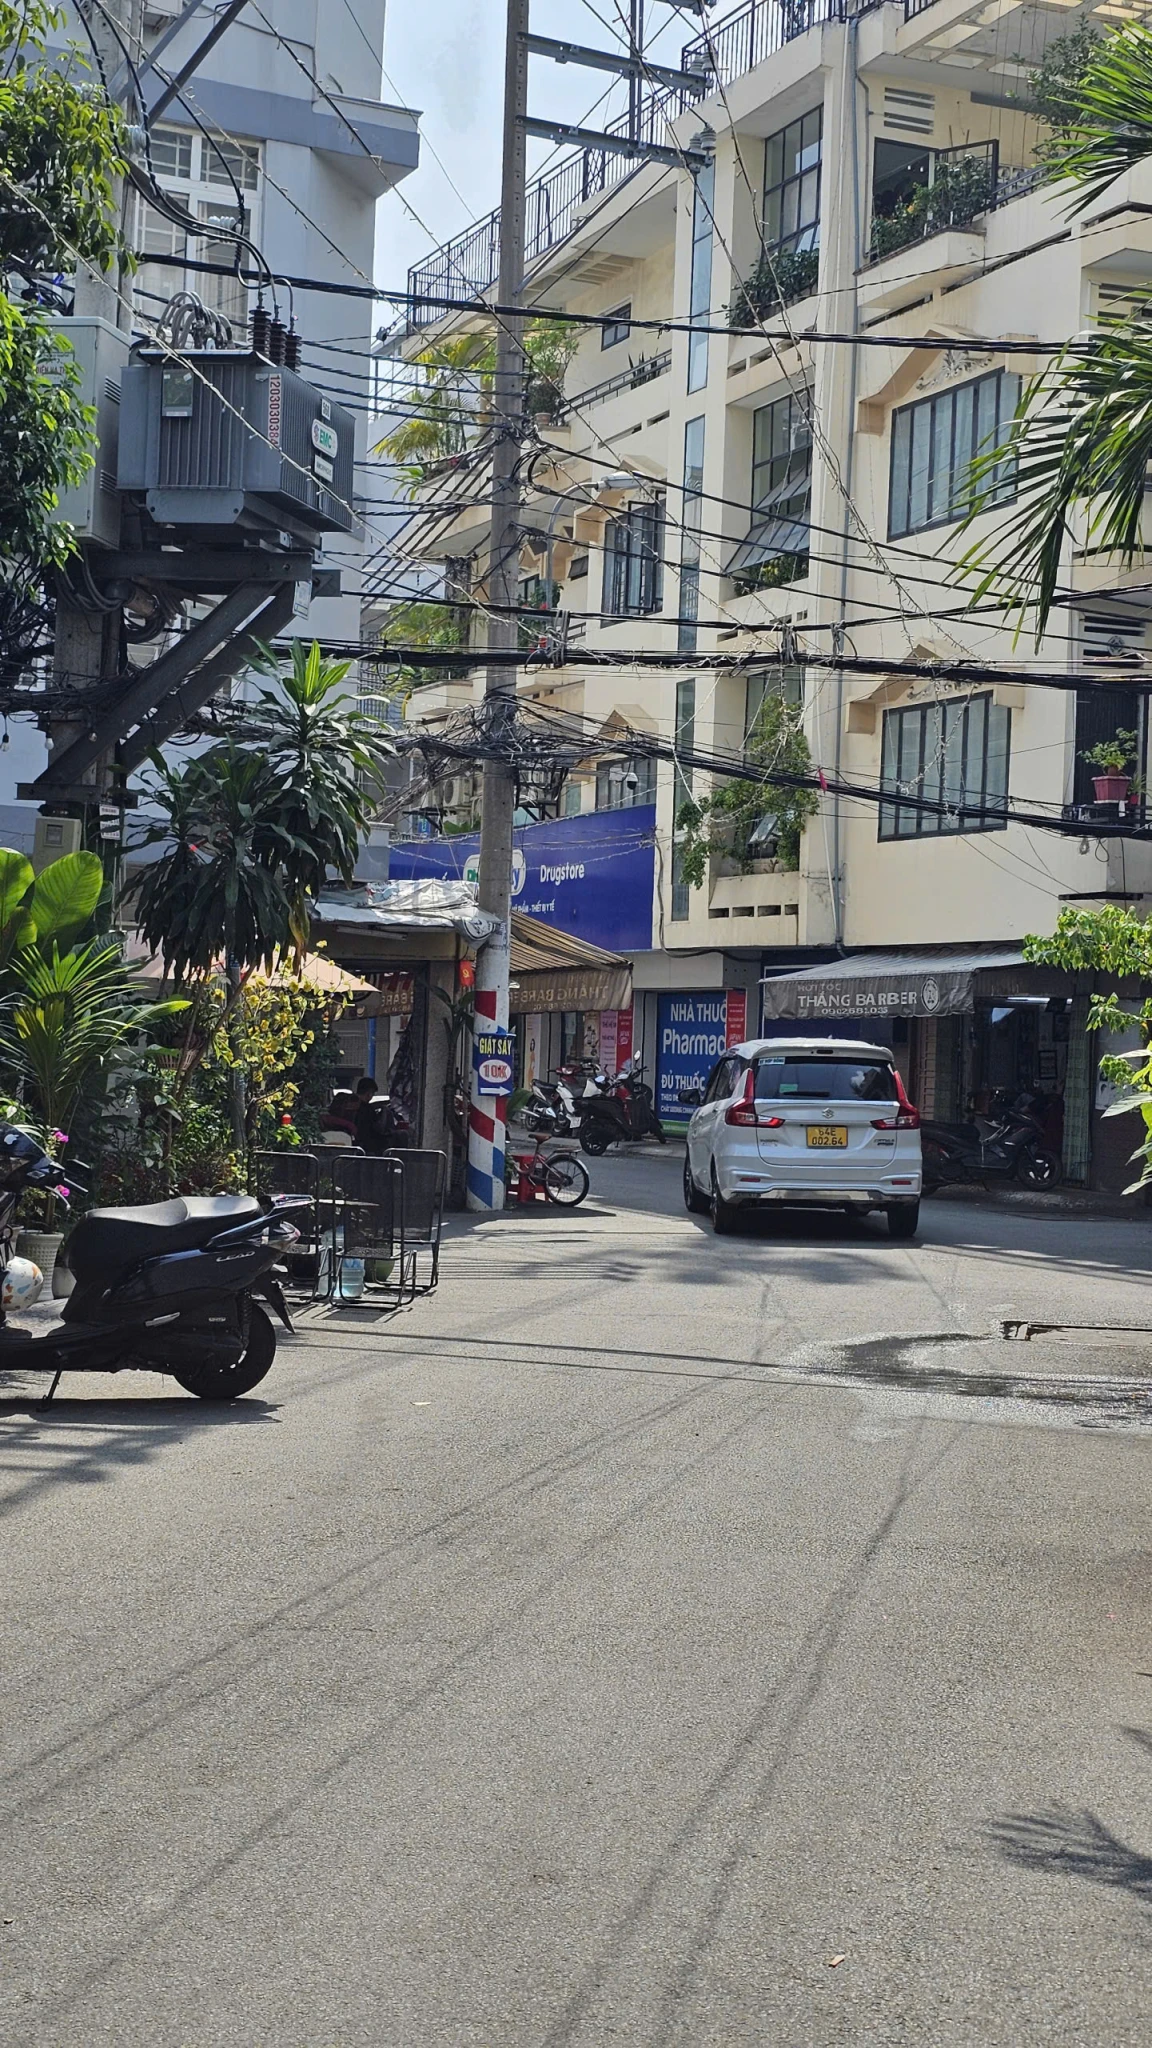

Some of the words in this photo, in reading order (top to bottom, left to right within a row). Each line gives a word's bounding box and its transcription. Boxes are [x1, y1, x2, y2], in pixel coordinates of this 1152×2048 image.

[539, 862, 585, 886] Drugstore
[855, 991, 917, 1006] BARBER
[670, 998, 695, 1022] NHÀ
[483, 1064, 508, 1079] 10K
[675, 1070, 706, 1092] THUỐC
[818, 1127, 836, 1137] 64E
[811, 1136, 844, 1146] 002.64
